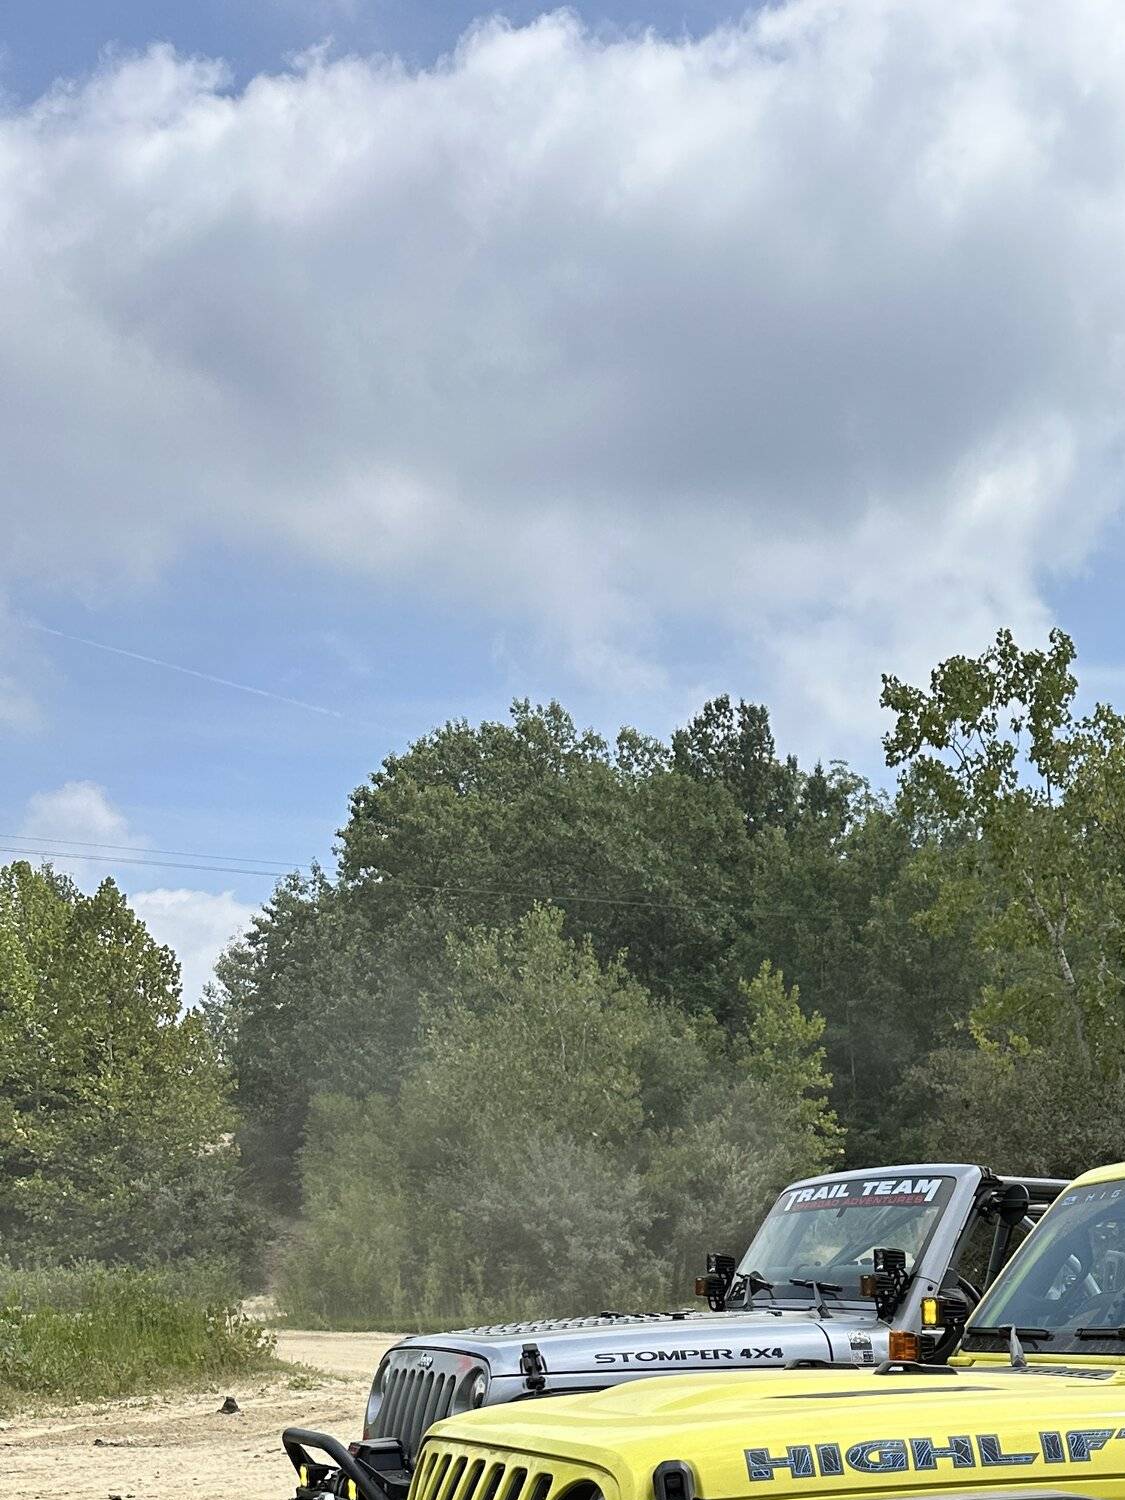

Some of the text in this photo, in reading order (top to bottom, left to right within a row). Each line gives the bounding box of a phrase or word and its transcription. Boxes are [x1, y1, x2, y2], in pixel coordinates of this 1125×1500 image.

[784, 1179, 943, 1211] TRAIL TEAM
[594, 1347, 785, 1364] STOMPER 4X4
